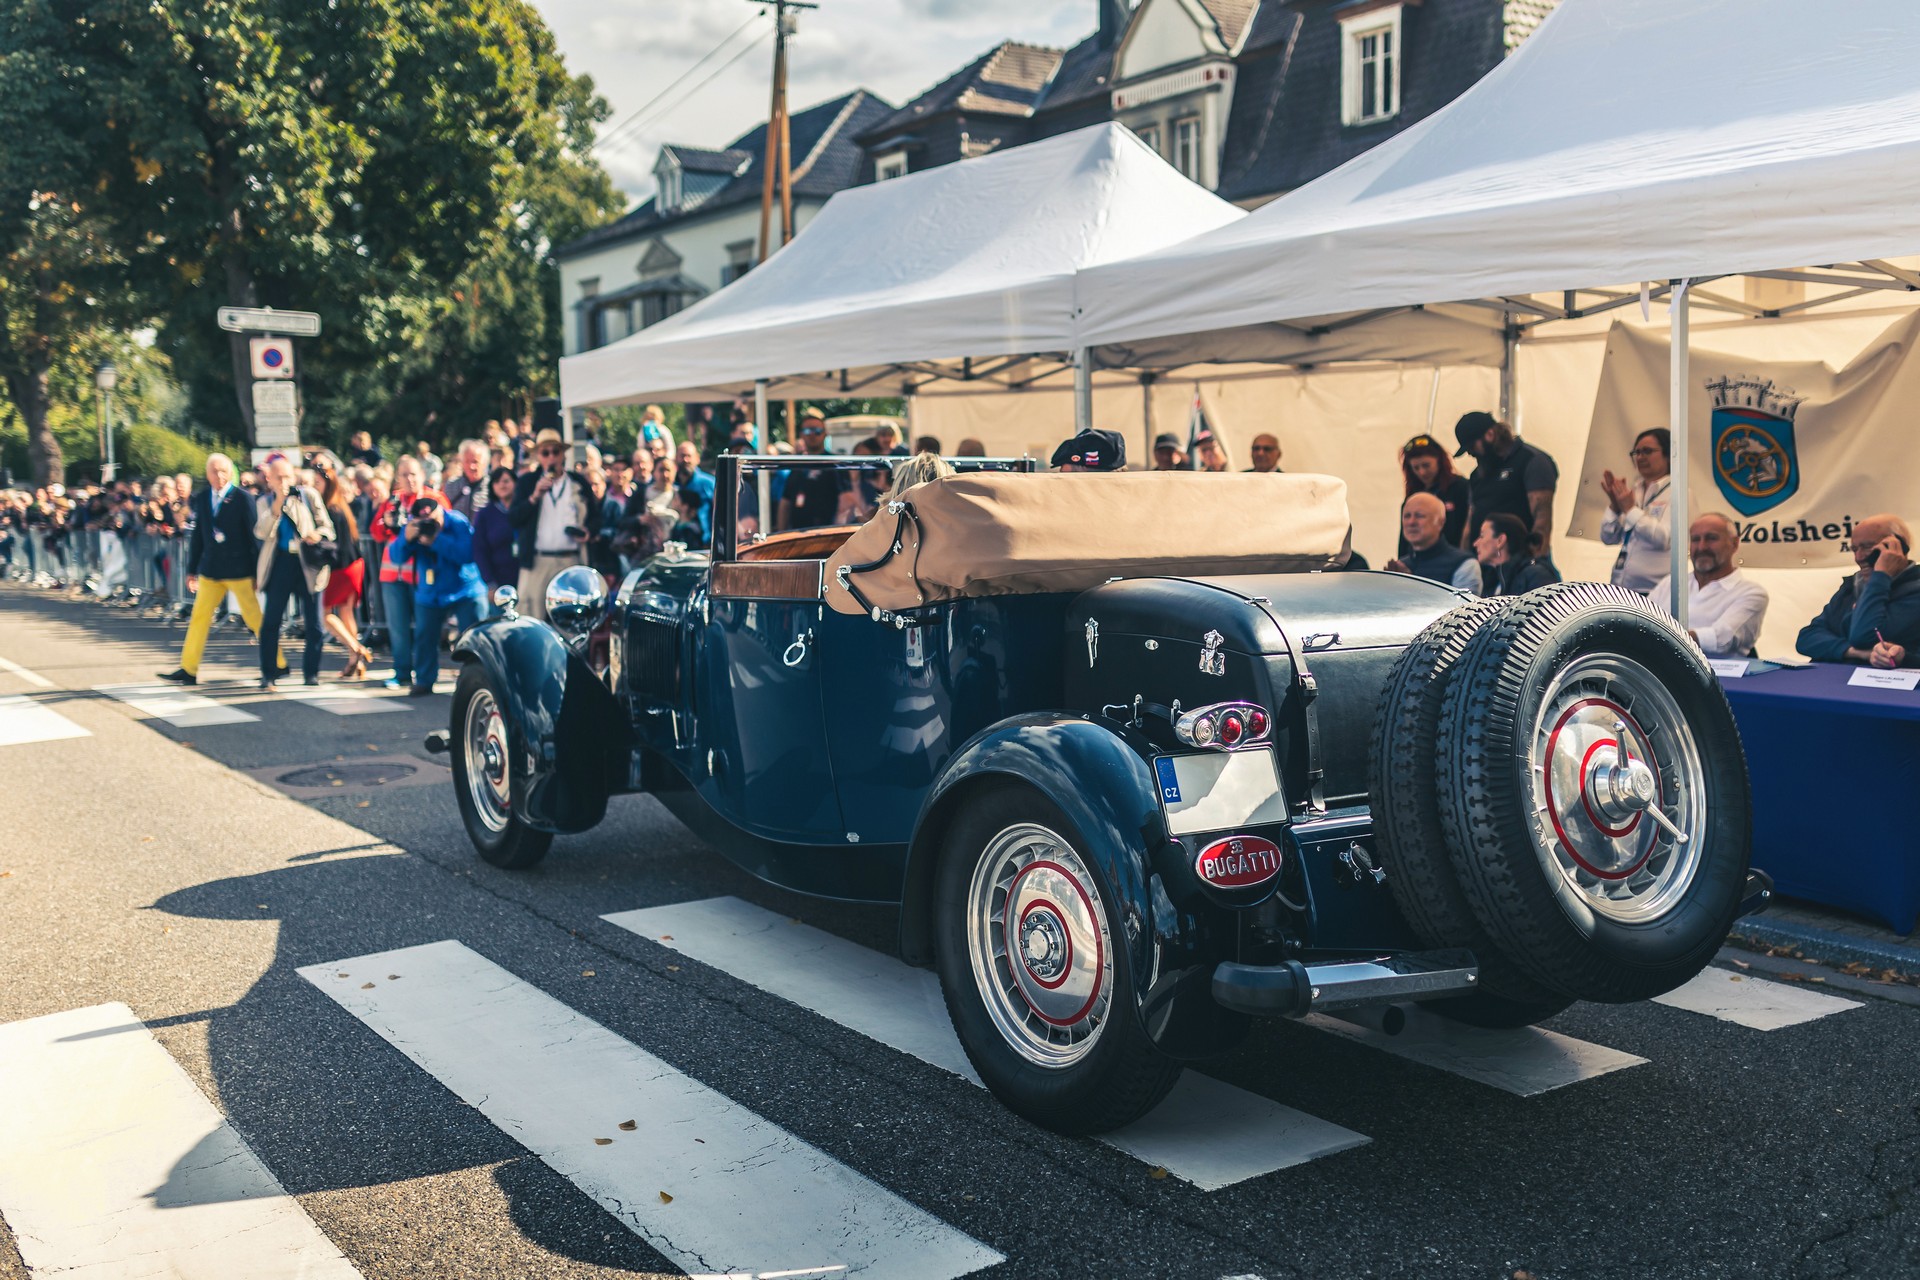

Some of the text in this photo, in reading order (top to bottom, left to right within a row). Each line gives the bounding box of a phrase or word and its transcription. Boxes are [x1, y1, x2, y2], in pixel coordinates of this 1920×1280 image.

[1734, 515, 1859, 543] Molshei
[1164, 787, 1179, 799] CZ
[1204, 850, 1277, 879] BUGATTI
